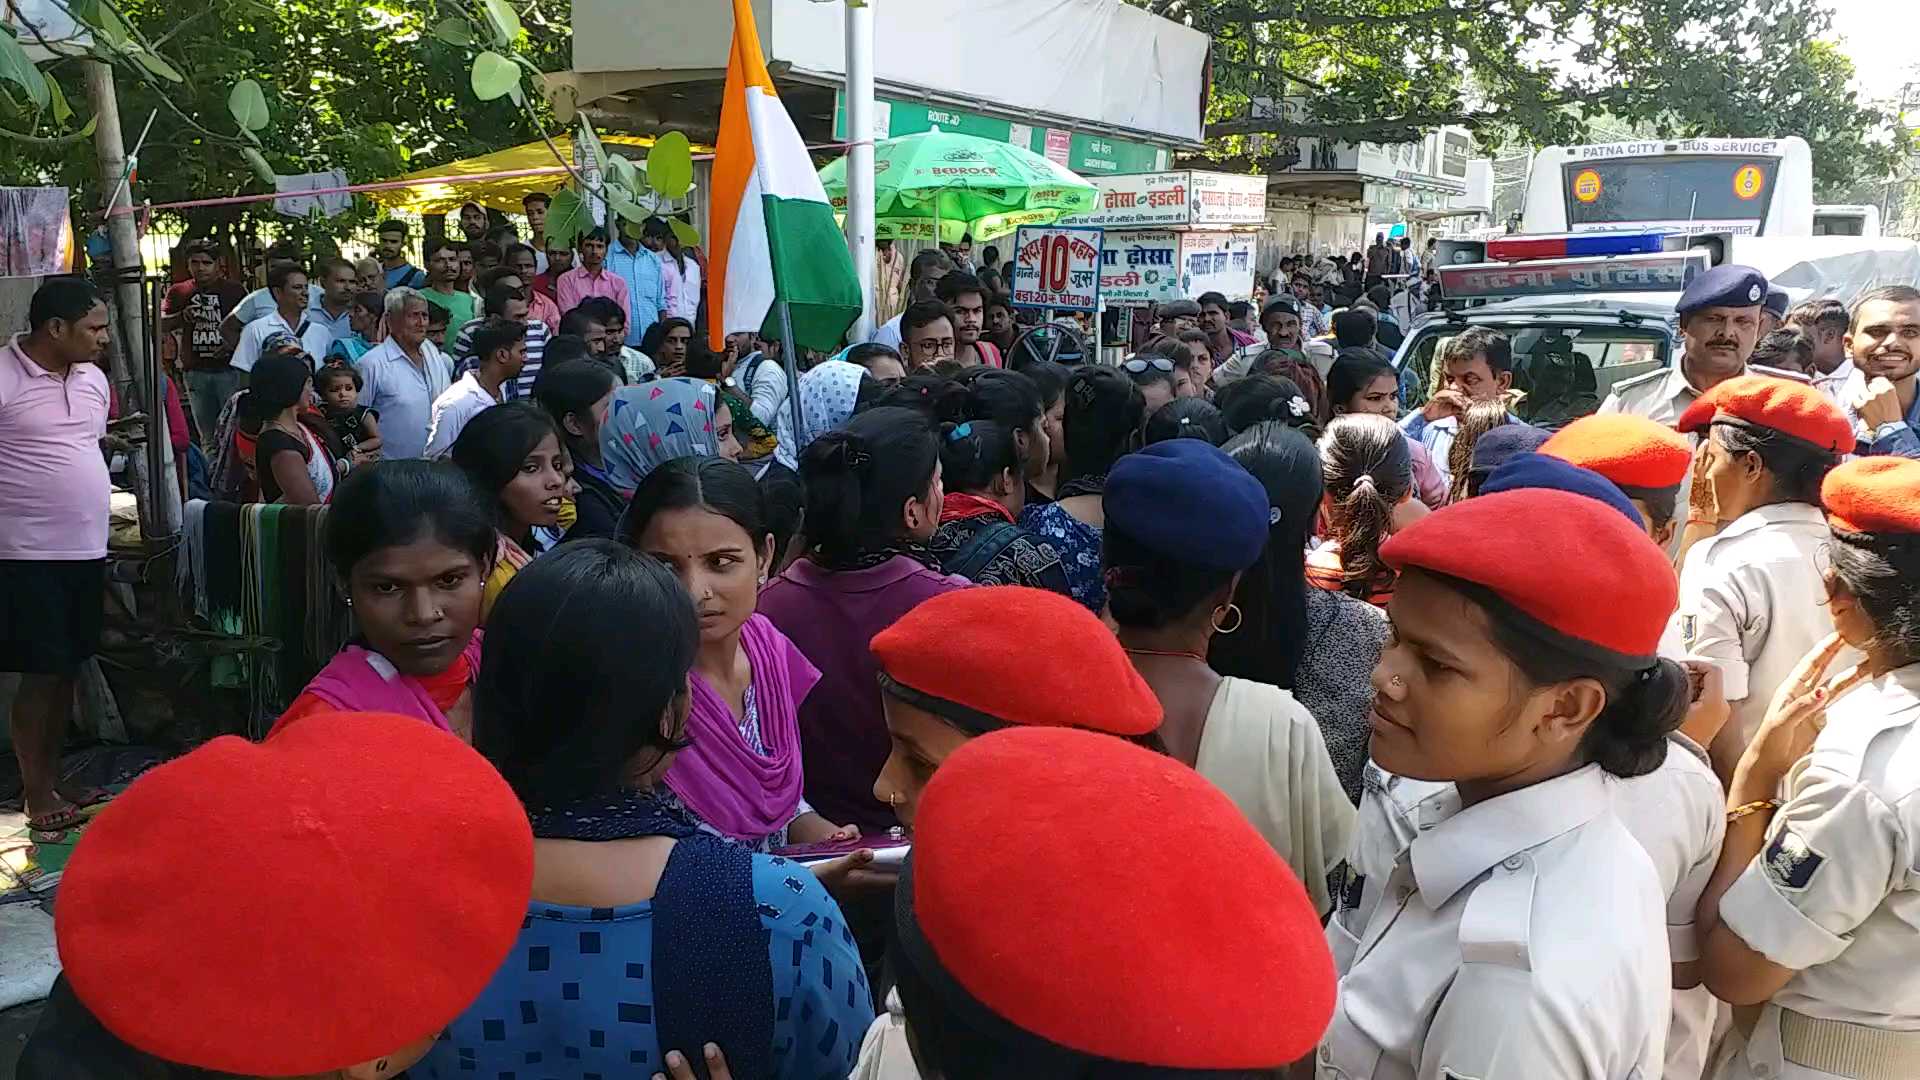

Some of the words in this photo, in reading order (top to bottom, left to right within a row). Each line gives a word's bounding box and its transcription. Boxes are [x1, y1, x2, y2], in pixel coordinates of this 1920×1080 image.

[928, 110, 949, 124] ROUTE
[1583, 144, 1625, 157] PATNA
[1627, 143, 1659, 154] CITY
[1682, 141, 1709, 151] BUS
[1713, 142, 1771, 153] SERVICE
[932, 166, 998, 176] BEDROCK
[1147, 185, 1186, 208] इडली
[1039, 235, 1069, 293] 10
[1070, 270, 1095, 288] जूस
[1464, 269, 1555, 290] पटना
[1567, 262, 1697, 289] पुलिस
